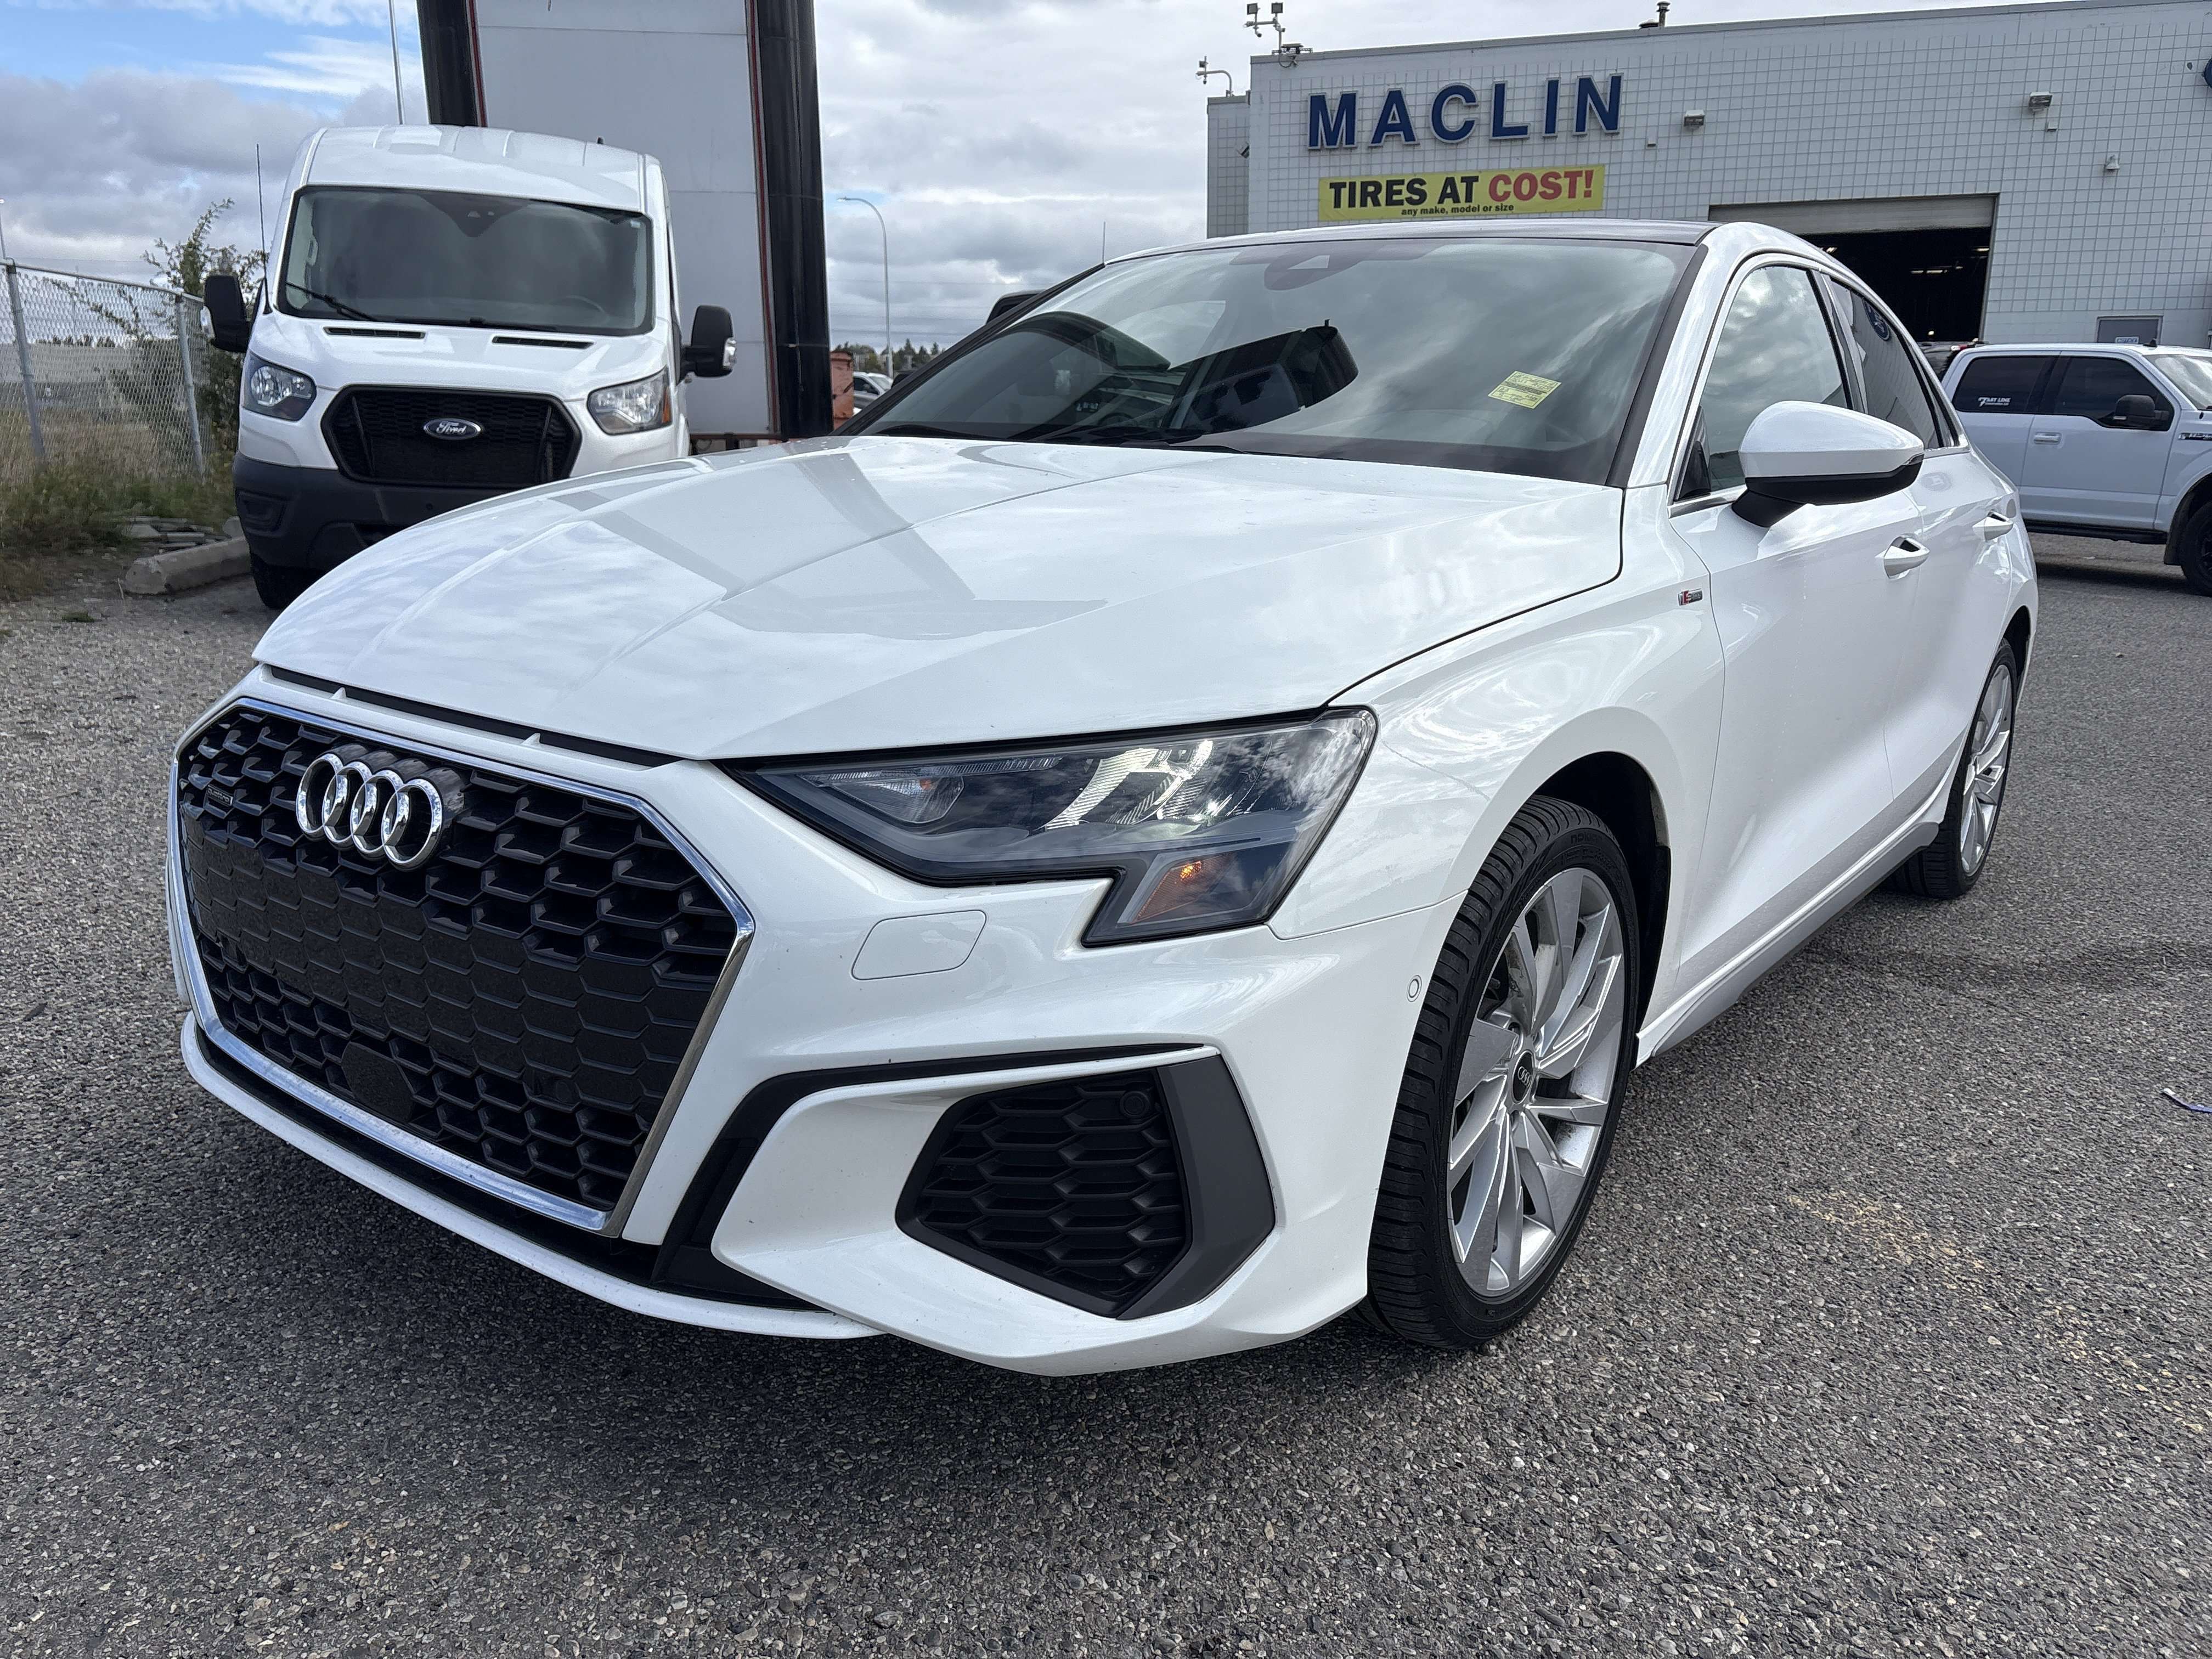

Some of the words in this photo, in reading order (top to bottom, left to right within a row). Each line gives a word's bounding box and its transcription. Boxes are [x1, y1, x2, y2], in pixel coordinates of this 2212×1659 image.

[1308, 74, 1623, 150] MACLIN
[1329, 178, 1427, 208] TIRES
[1437, 176, 1479, 205] AT
[1488, 170, 1594, 202] COST!
[1401, 208, 1418, 216] any
[1420, 206, 1448, 215] make,
[1451, 205, 1480, 213] model
[1495, 203, 1514, 211] size
[436, 421, 467, 435] Ford
